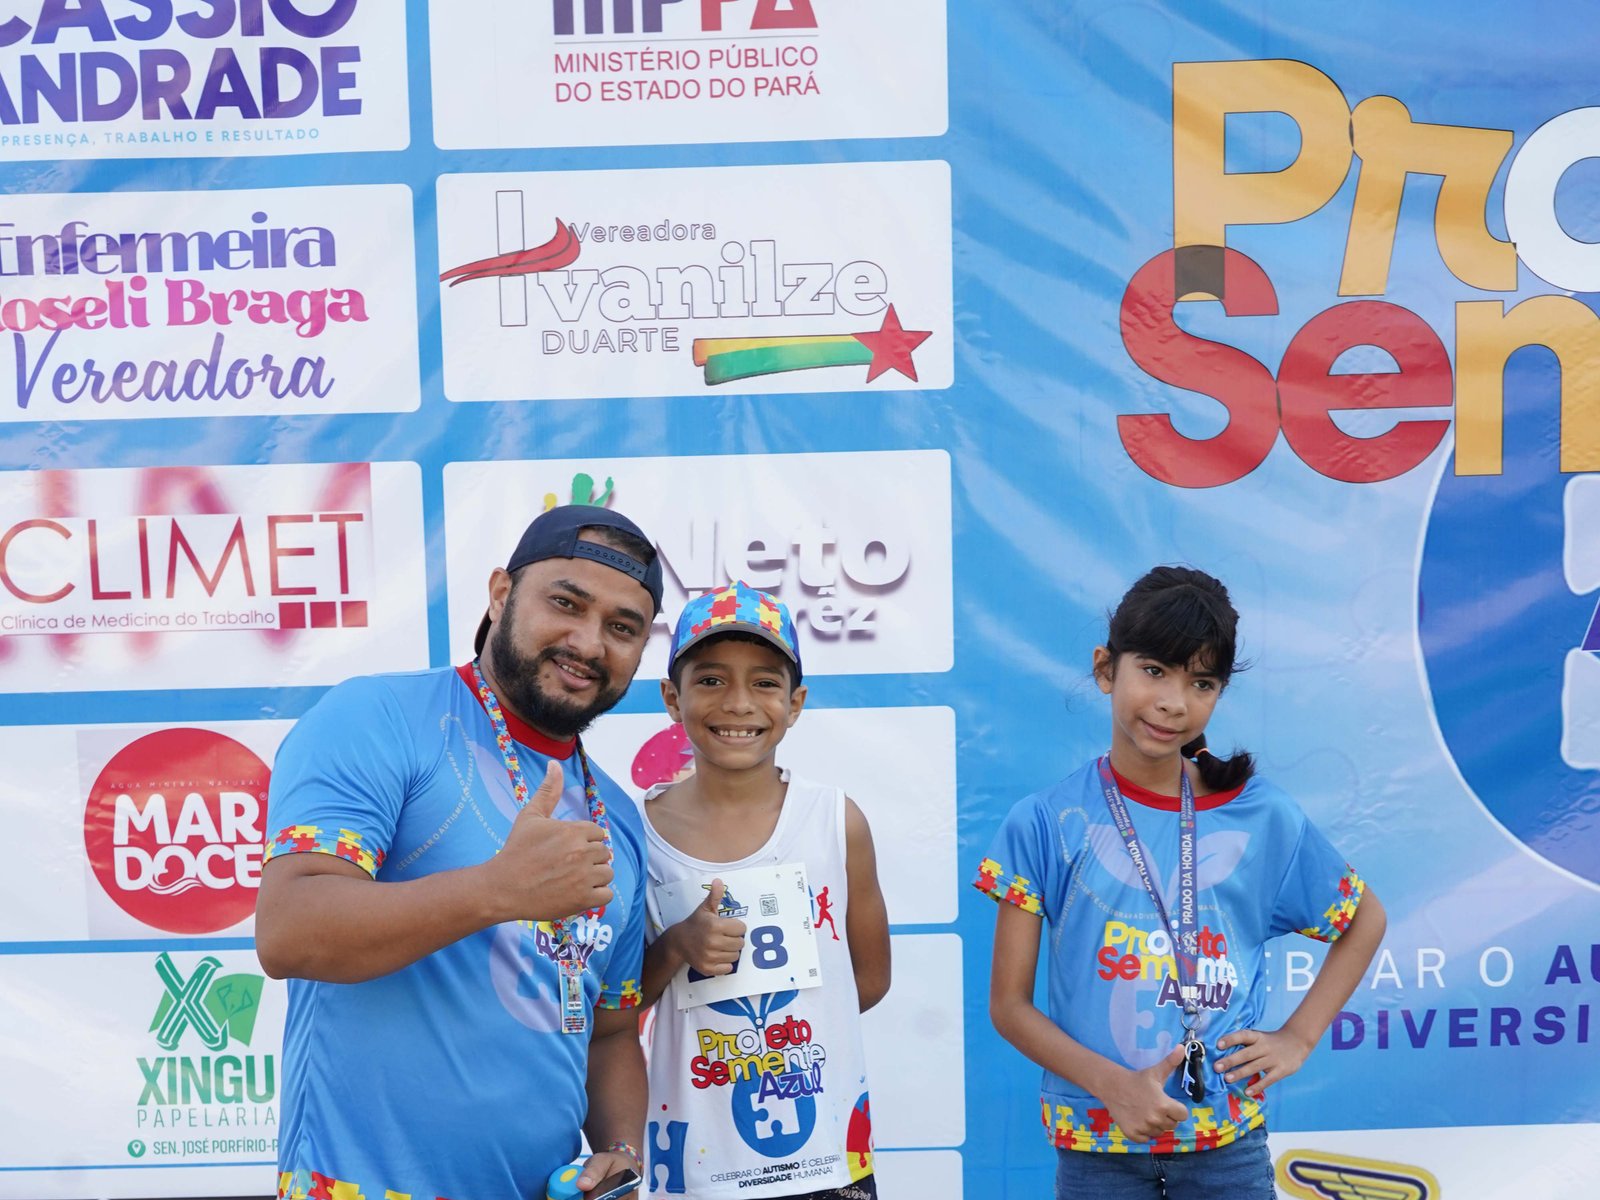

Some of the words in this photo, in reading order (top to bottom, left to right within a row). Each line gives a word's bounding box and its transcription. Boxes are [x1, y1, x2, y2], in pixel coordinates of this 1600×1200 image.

[554, 47, 700, 73] MINISTÉRIO
[709, 44, 818, 69] PÚBLICO
[555, 82, 591, 102] DO
[600, 79, 700, 101] ESTADO
[709, 78, 745, 98] DO
[754, 71, 820, 96] PARÁ
[1, 133, 97, 148] PRESENÇA,
[104, 131, 198, 144] TRABALHO
[205, 131, 214, 142] E
[221, 129, 320, 142] RESULTADO
[571, 219, 716, 243] Vereadora
[496, 190, 888, 327] Ivanilze
[0, 276, 151, 332] oseli
[165, 278, 369, 338] Braga
[541, 328, 679, 354] DUARTE
[14, 329, 335, 409] Vereadora
[0, 513, 363, 603] CLIMET
[1, 612, 58, 630] Clínica
[63, 613, 85, 629] de
[91, 611, 170, 628] Medicina
[175, 611, 197, 626] do
[202, 610, 275, 625] Trabalho
[113, 792, 263, 845] MAR
[113, 844, 264, 896] DOCE
[1182, 833, 1193, 870] HONDA
[1182, 873, 1193, 886] DA
[1182, 887, 1193, 924] PRADO
[1098, 946, 1238, 987] Semnte
[1479, 946, 1514, 987] O
[697, 1015, 812, 1060] Projeto
[136, 1054, 276, 1106] XINGU
[691, 1042, 826, 1089] Semente
[758, 1062, 824, 1104] Azul
[137, 1106, 276, 1129] PAPELARIA
[153, 1140, 180, 1155] SEN.
[182, 1138, 210, 1156] JOSÉ
[711, 1169, 752, 1182] CELEBRAR
[753, 1167, 762, 1176] O
[762, 1162, 800, 1175] AUTISMO
[738, 1173, 792, 1188] DIVERSIDADE
